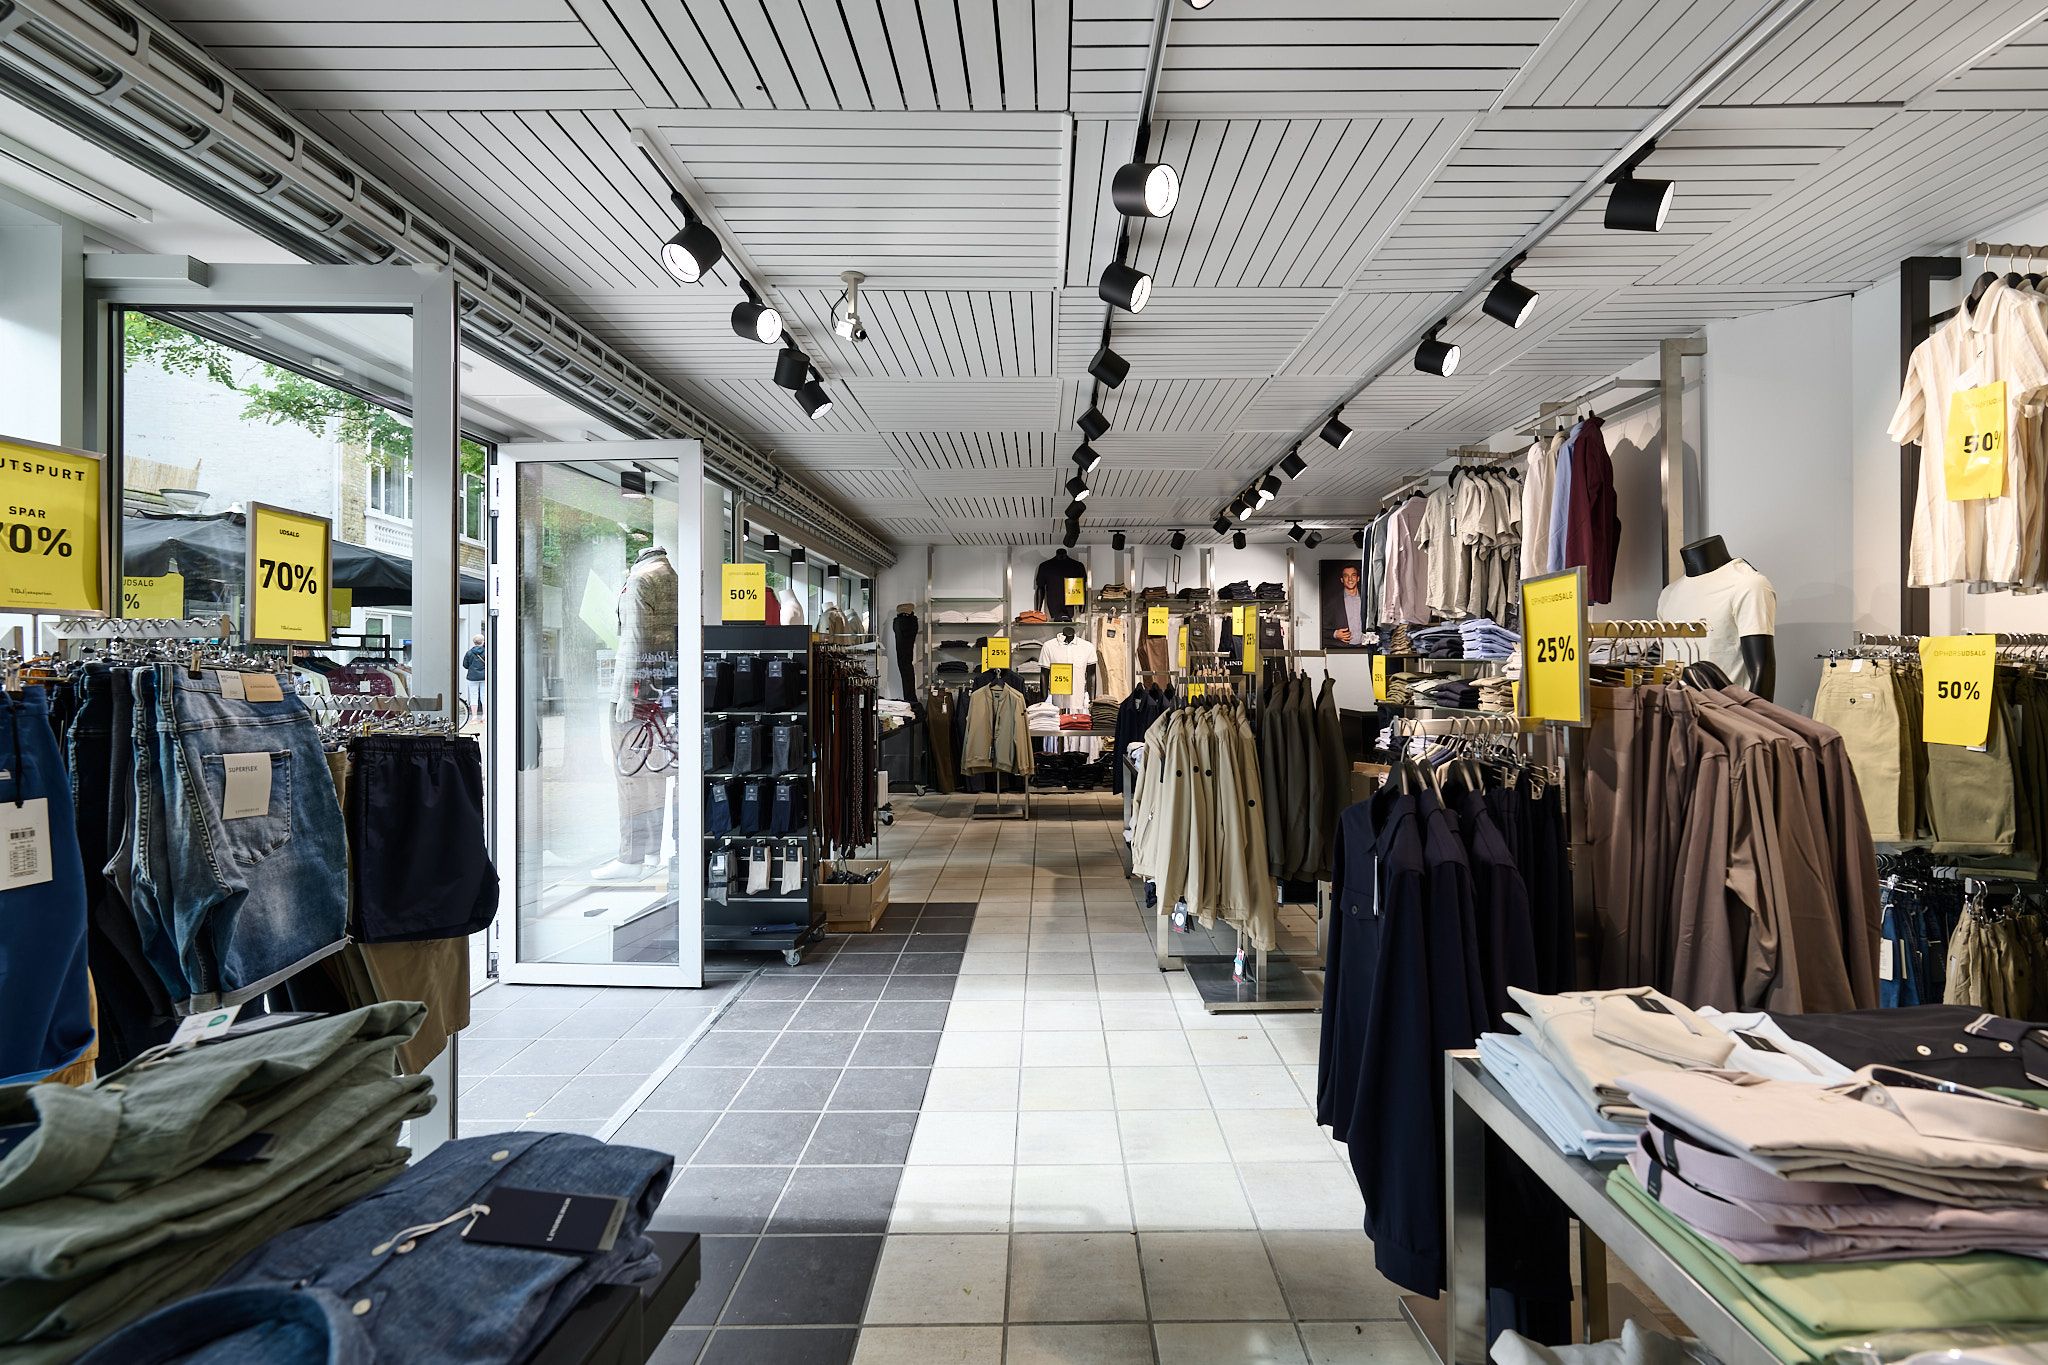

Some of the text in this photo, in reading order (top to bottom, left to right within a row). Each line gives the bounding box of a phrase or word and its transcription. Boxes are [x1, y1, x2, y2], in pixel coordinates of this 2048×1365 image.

[8, 505, 46, 519] SPAR
[279, 529, 300, 538] UDSALG
[259, 558, 318, 595] 70%
[730, 588, 758, 600] 50%
[1537, 635, 1575, 663] 25%
[1054, 675, 1069, 683] 25%
[1938, 681, 1980, 700] 50%
[228, 766, 258, 774] SUPERFLEX
